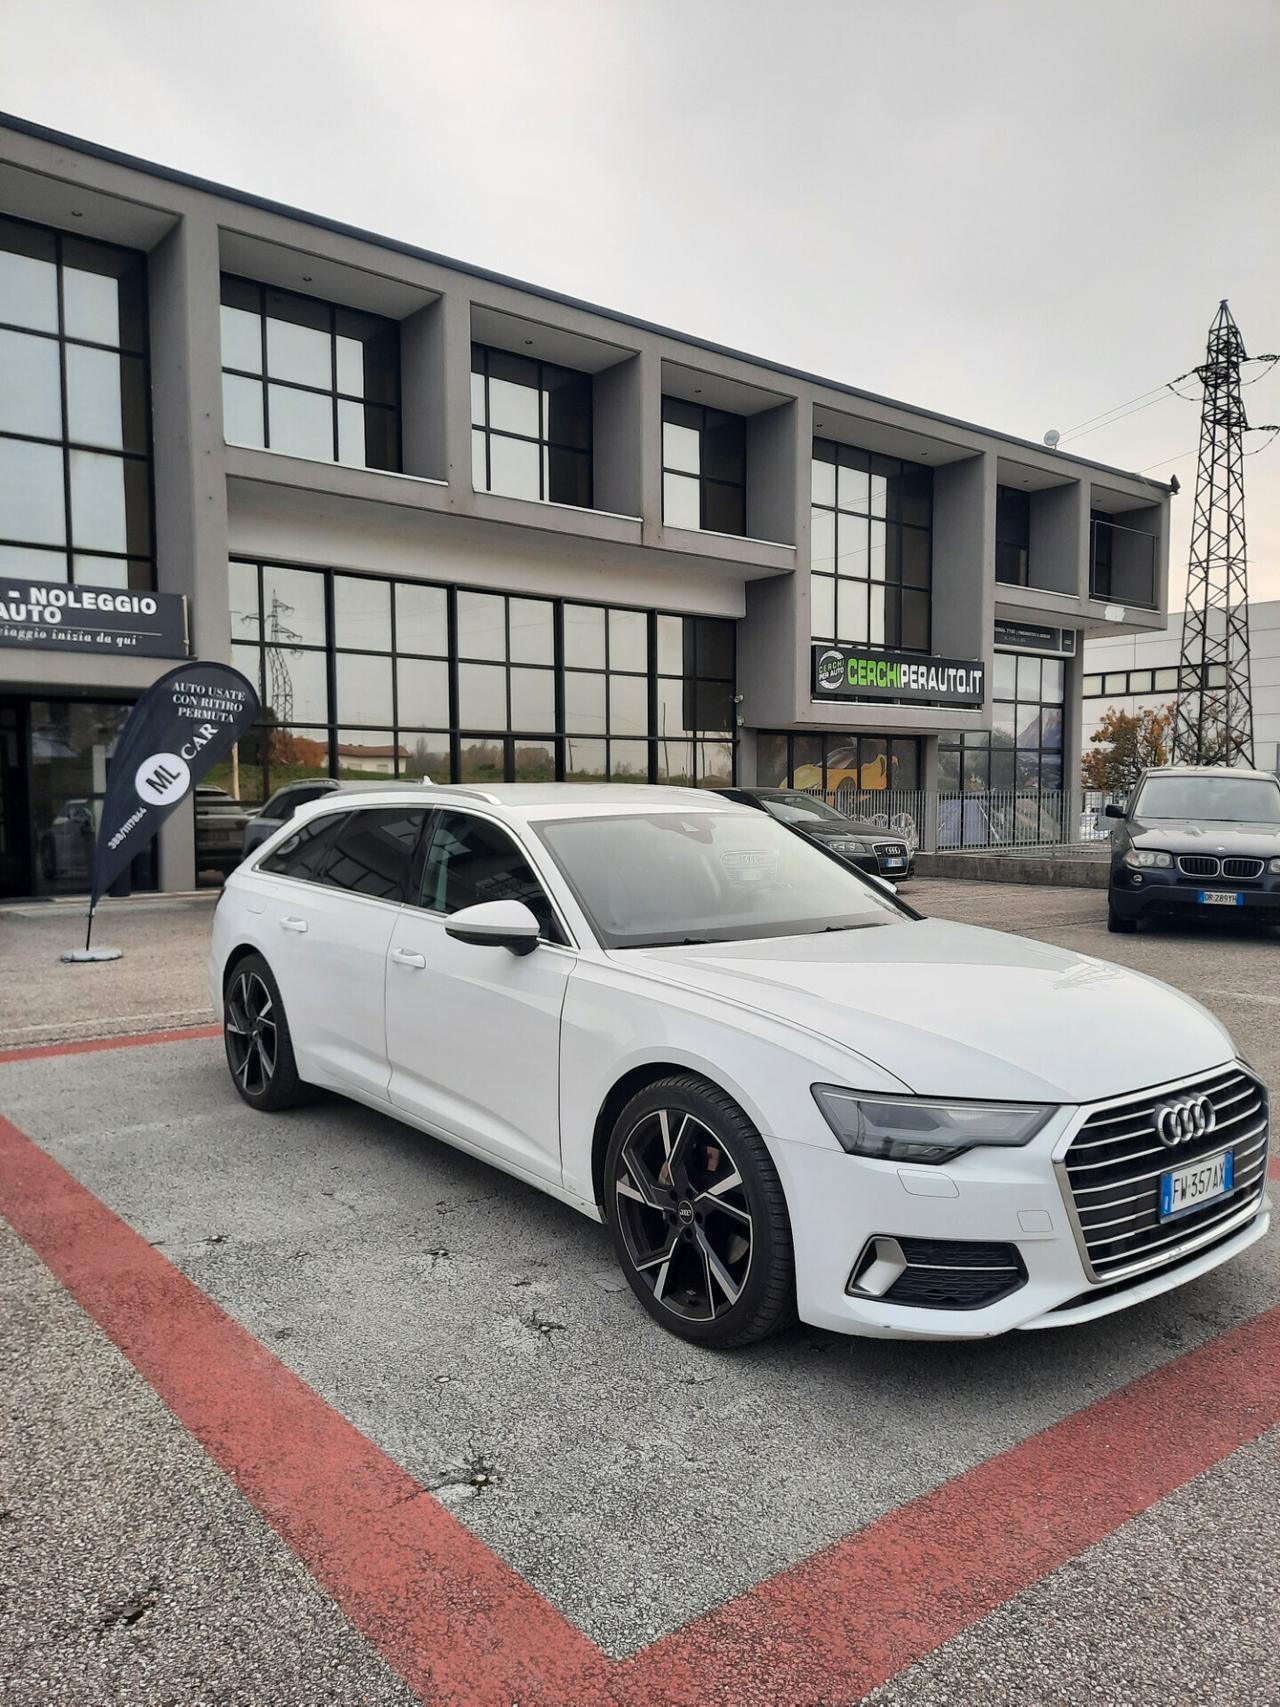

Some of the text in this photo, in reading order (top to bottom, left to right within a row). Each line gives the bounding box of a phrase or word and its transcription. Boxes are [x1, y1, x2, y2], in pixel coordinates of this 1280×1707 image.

[30, 587, 157, 615] NOLEGGIO
[51, 629, 92, 642] inizia
[96, 631, 112, 643] da
[818, 659, 845, 673] CERCHI
[818, 667, 844, 680] PER AUTO
[847, 658, 983, 694] CERCHIPERAUTO.IT
[172, 682, 246, 701] AUTO USATE
[172, 694, 243, 712] CON RITIRO
[178, 707, 234, 722] PERMUTA
[181, 723, 219, 760] CAR
[145, 764, 182, 795] ML
